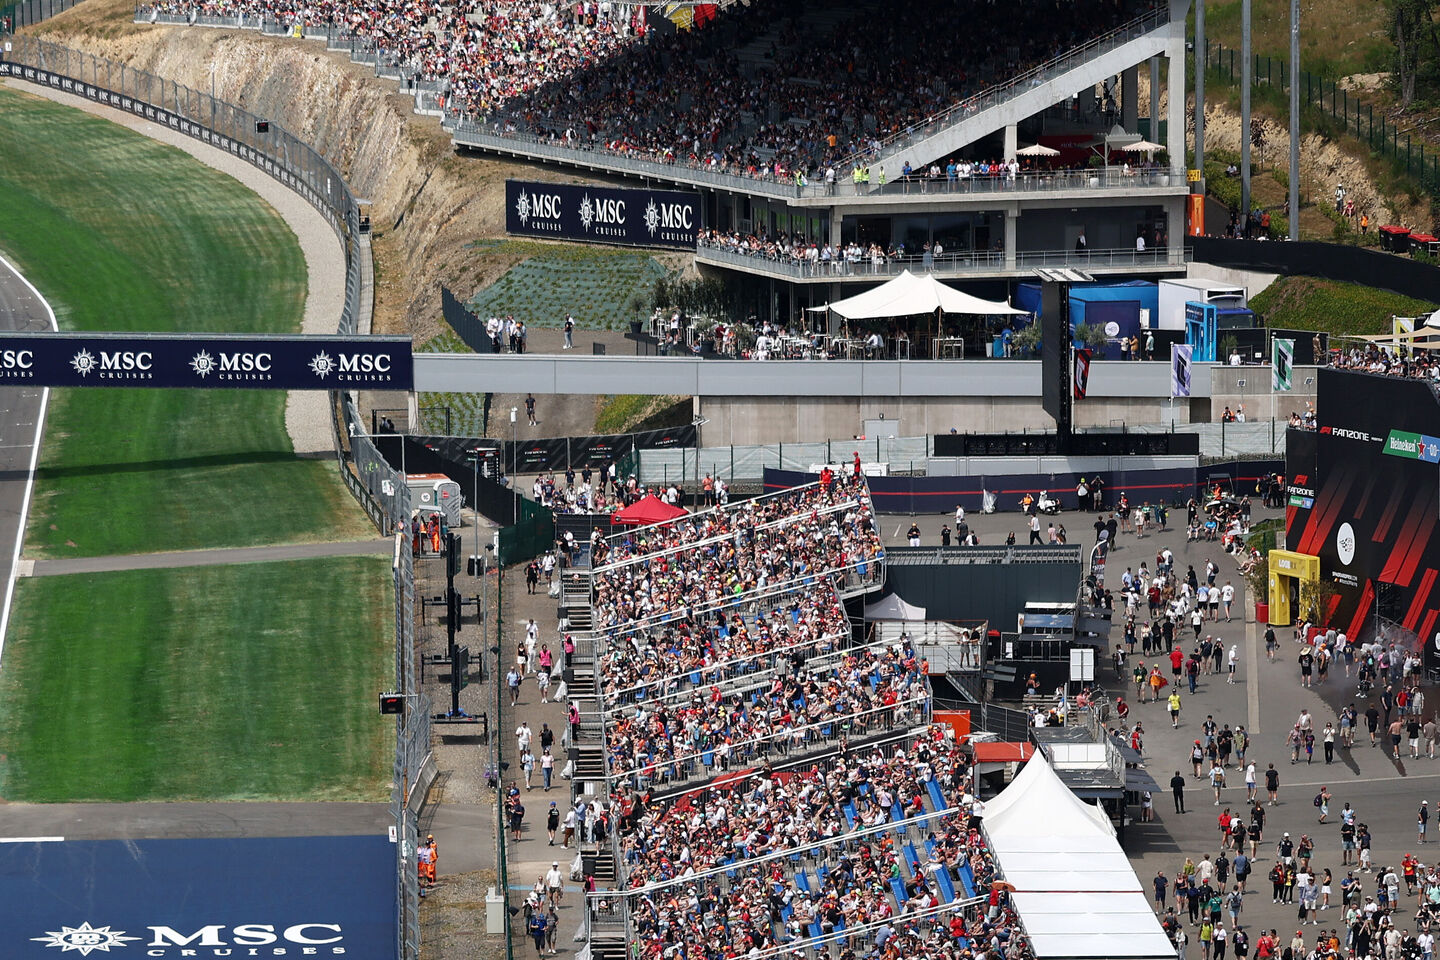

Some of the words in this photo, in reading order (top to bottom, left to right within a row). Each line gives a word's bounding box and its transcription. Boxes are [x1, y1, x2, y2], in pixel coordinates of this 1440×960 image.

[532, 194, 561, 219] MSC
[595, 199, 626, 224] MSC
[660, 203, 692, 229] MSC
[532, 222, 562, 232] CRUISES
[595, 226, 626, 237] CRUISES
[661, 232, 693, 242] CRUISES
[100, 352, 152, 370] MSC
[220, 352, 272, 371] MSC
[338, 354, 391, 372] MSC
[338, 374, 391, 382] CRUISES
[1332, 427, 1370, 442] FANZONE
[1390, 437, 1416, 453] Heineken
[1287, 486, 1315, 497] FANZONE
[146, 923, 344, 946] MSC
[146, 946, 346, 957] CRUISES
